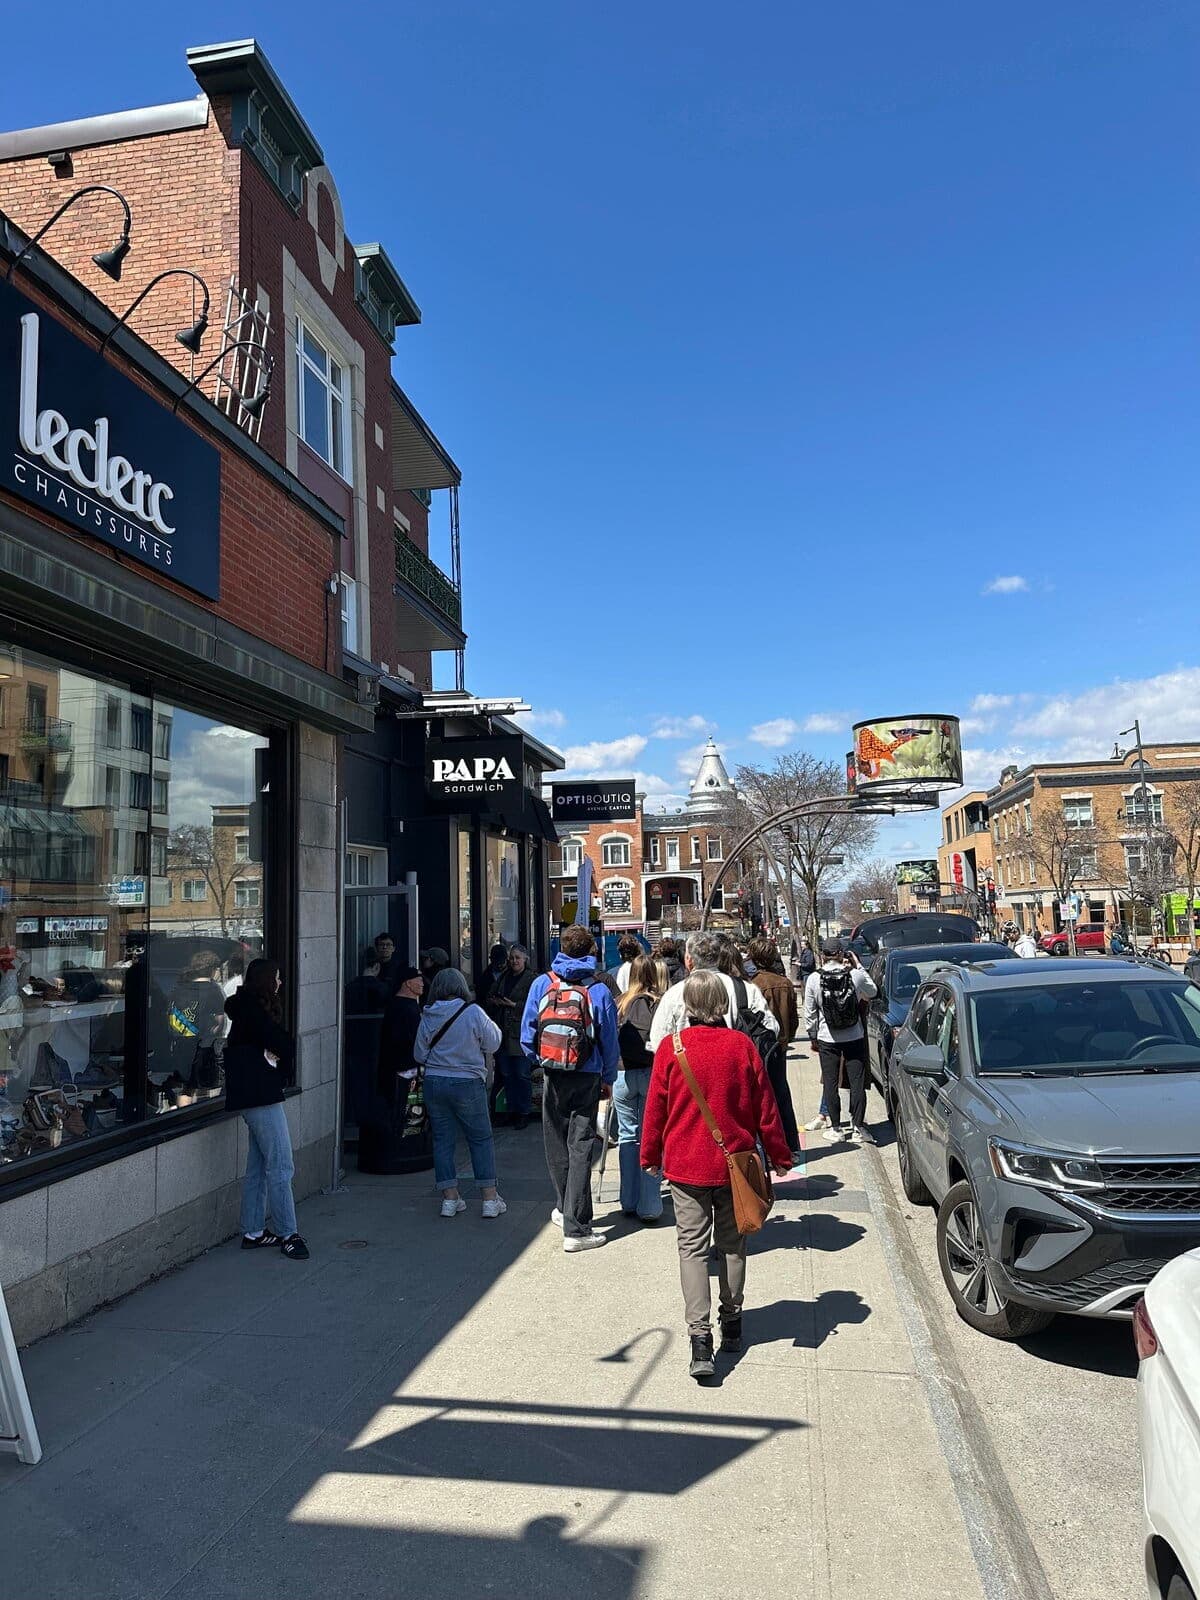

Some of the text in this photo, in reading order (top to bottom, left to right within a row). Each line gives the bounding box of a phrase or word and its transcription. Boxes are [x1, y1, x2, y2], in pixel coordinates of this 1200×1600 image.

[14, 463, 173, 566] CHAUSSURES
[432, 757, 516, 782] PAPA
[444, 783, 504, 793] sandwich
[556, 793, 631, 805] OPTIBOUTIQ
